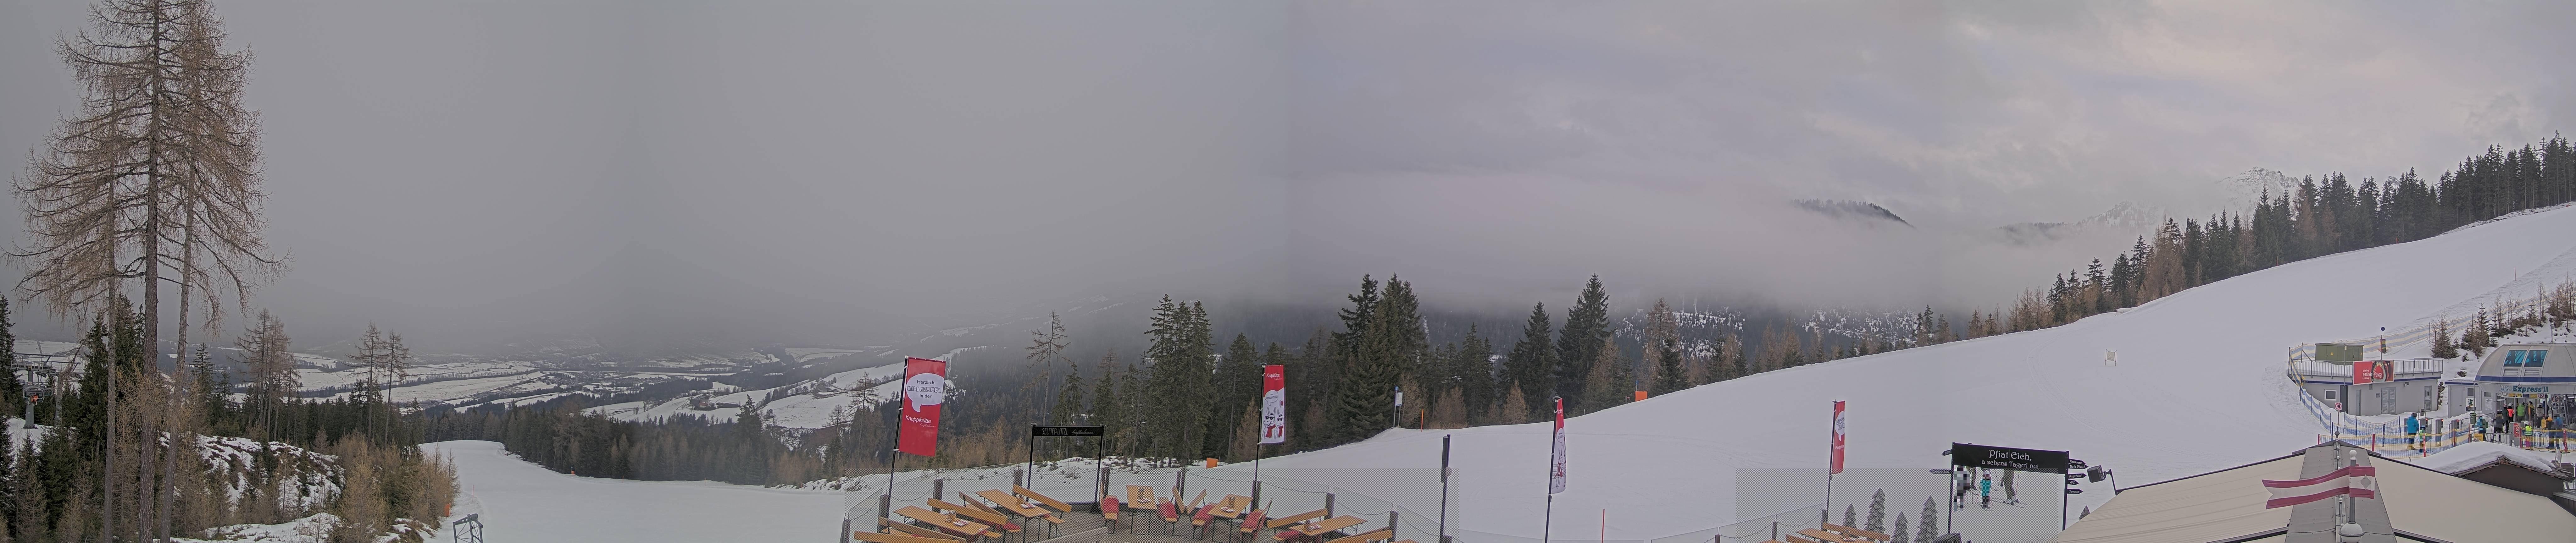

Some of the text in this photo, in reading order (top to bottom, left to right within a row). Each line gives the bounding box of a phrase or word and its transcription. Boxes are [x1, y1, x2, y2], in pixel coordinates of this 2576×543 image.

[2512, 385, 2542, 393] Express
[905, 415, 931, 423] Knapplhütte
[1989, 450, 2032, 461] Pfiat Eich,
